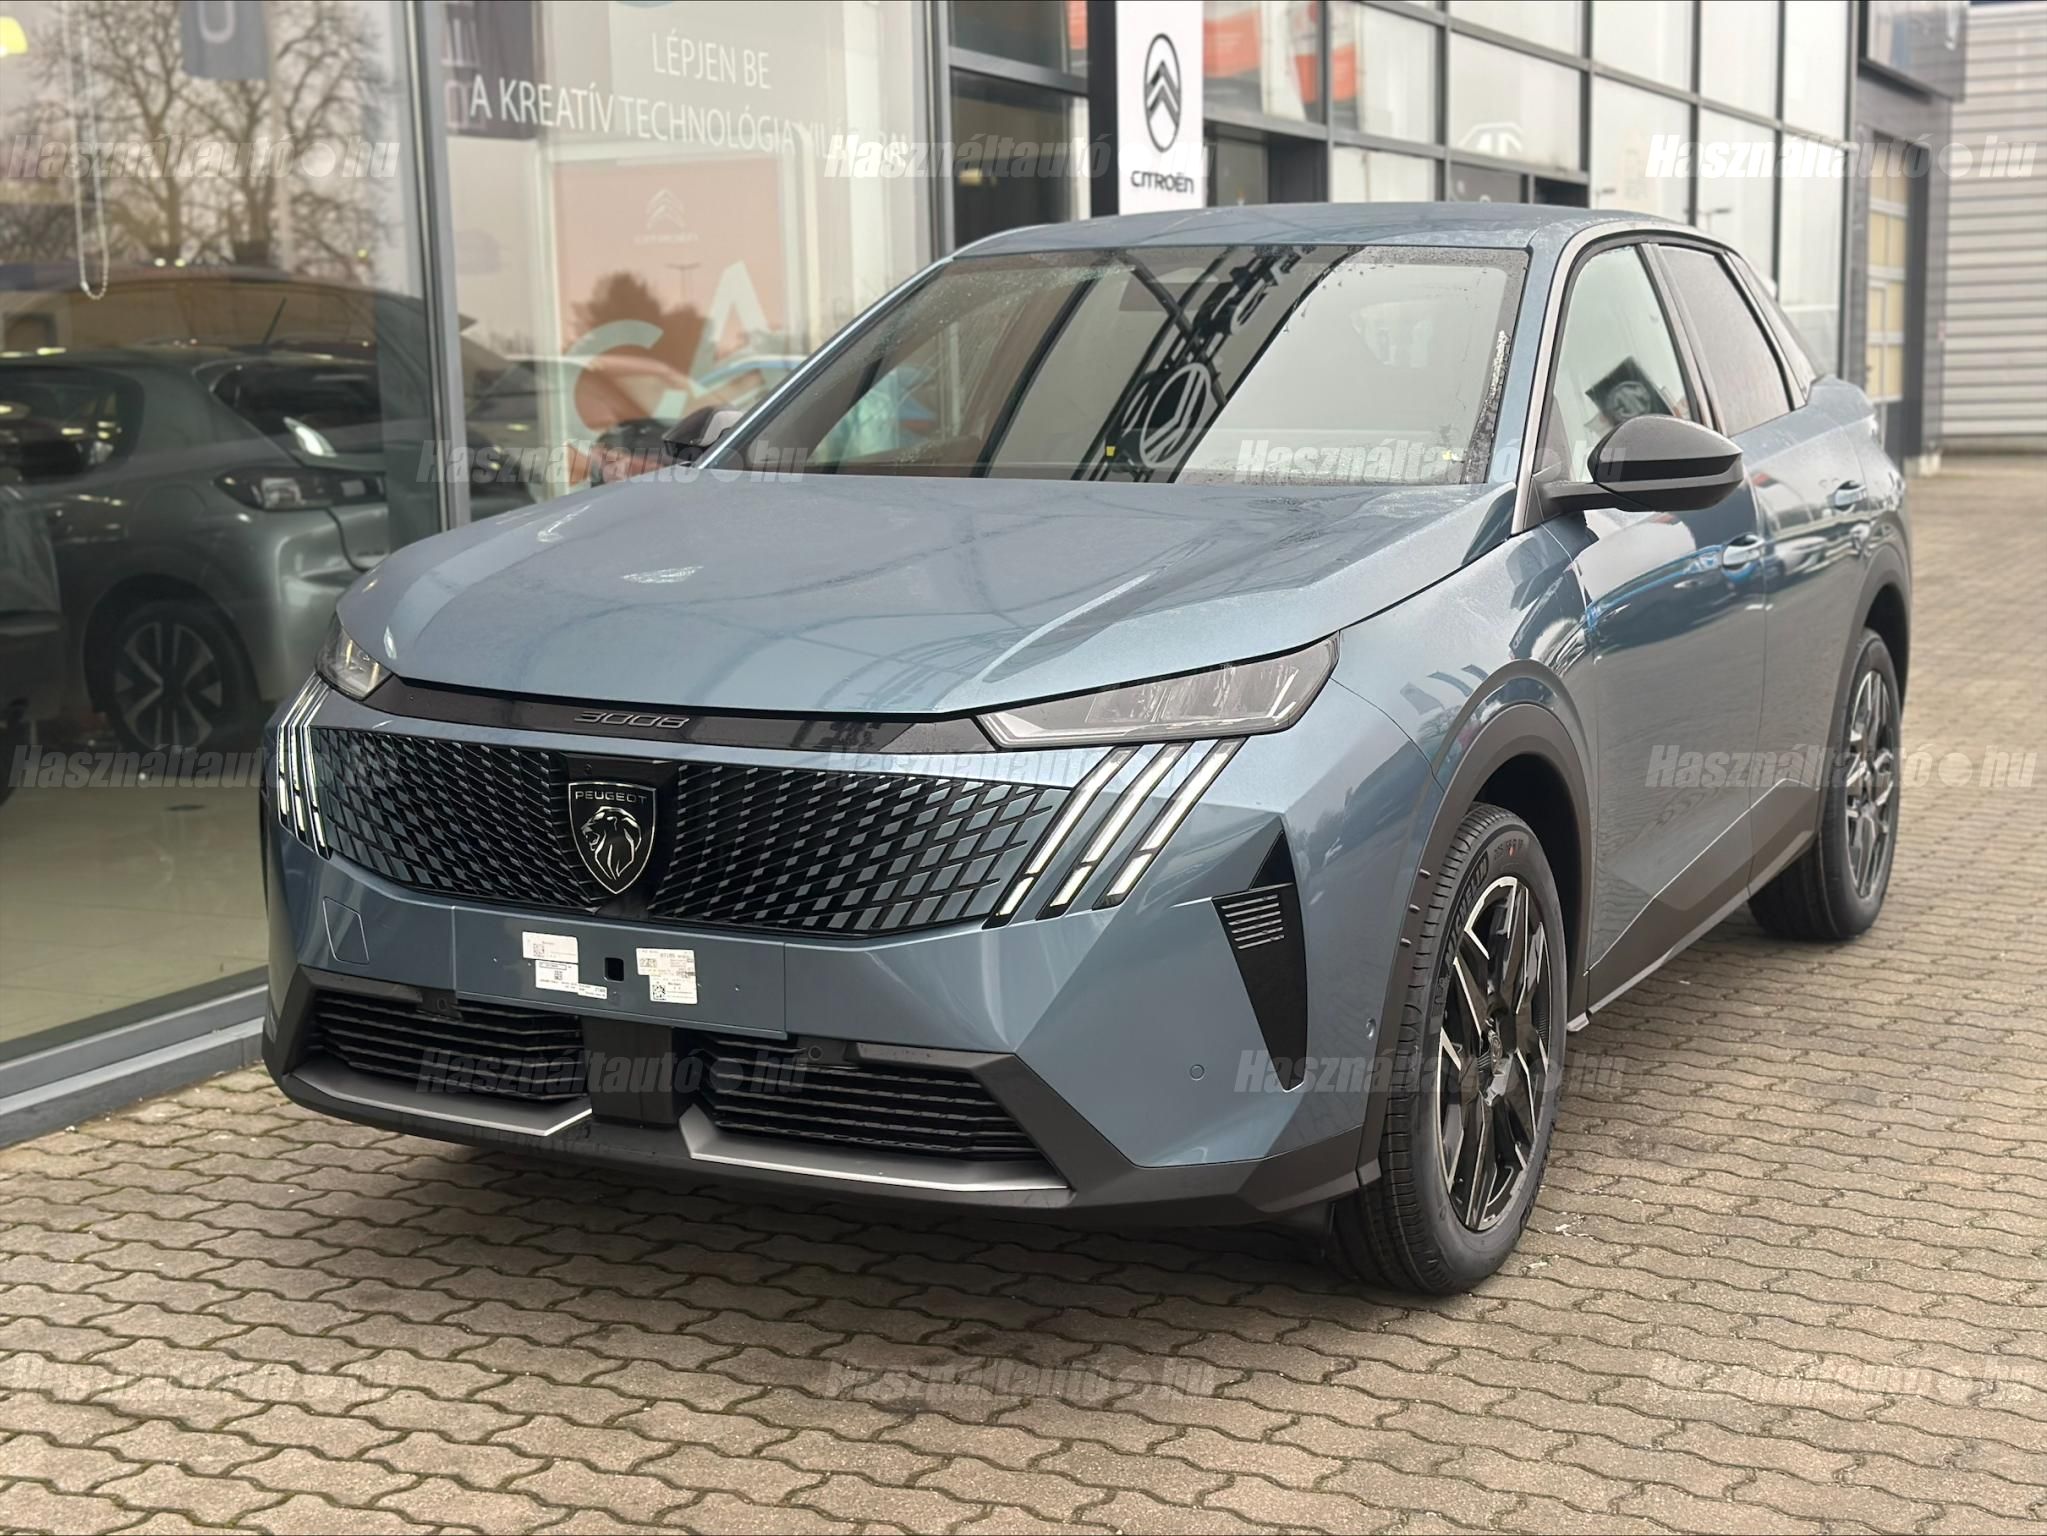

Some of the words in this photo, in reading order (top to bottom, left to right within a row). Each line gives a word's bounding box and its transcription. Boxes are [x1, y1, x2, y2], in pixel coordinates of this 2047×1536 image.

[651, 28, 737, 84] LÉPJEN
[742, 49, 772, 89] BE
[469, 74, 493, 119] A
[499, 77, 614, 133] KREATÍV
[618, 95, 795, 154] TECHNOLÓGIA
[1130, 170, 1195, 194] CITROËN
[573, 711, 690, 729] 3008
[574, 790, 648, 804] PEUGEOT
